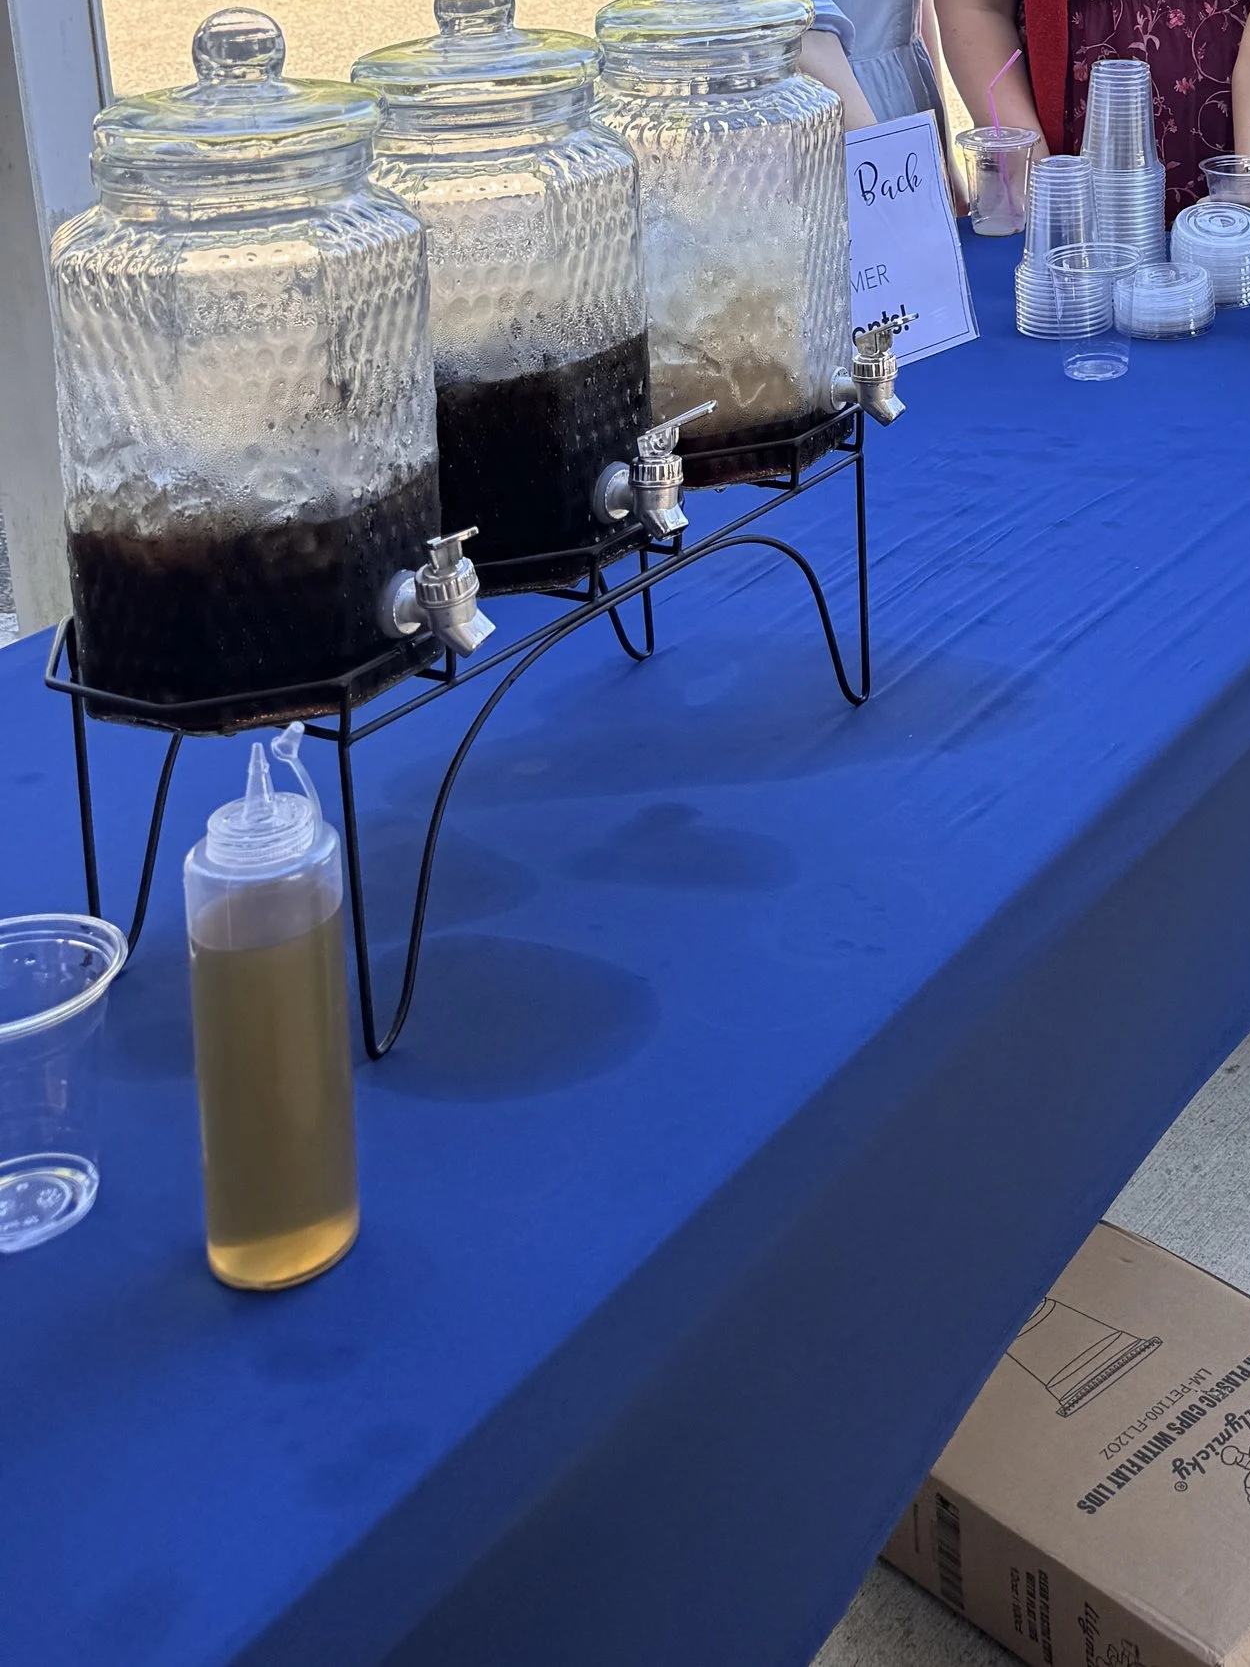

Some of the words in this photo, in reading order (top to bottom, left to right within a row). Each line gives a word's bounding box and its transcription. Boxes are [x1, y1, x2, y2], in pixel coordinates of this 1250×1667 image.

[853, 152, 922, 206] Back
[1166, 1403, 1207, 1435] CUPS
[1132, 1430, 1177, 1465] WITH
[1106, 1458, 1144, 1490] FLAT
[1076, 1483, 1116, 1514] LIDS
